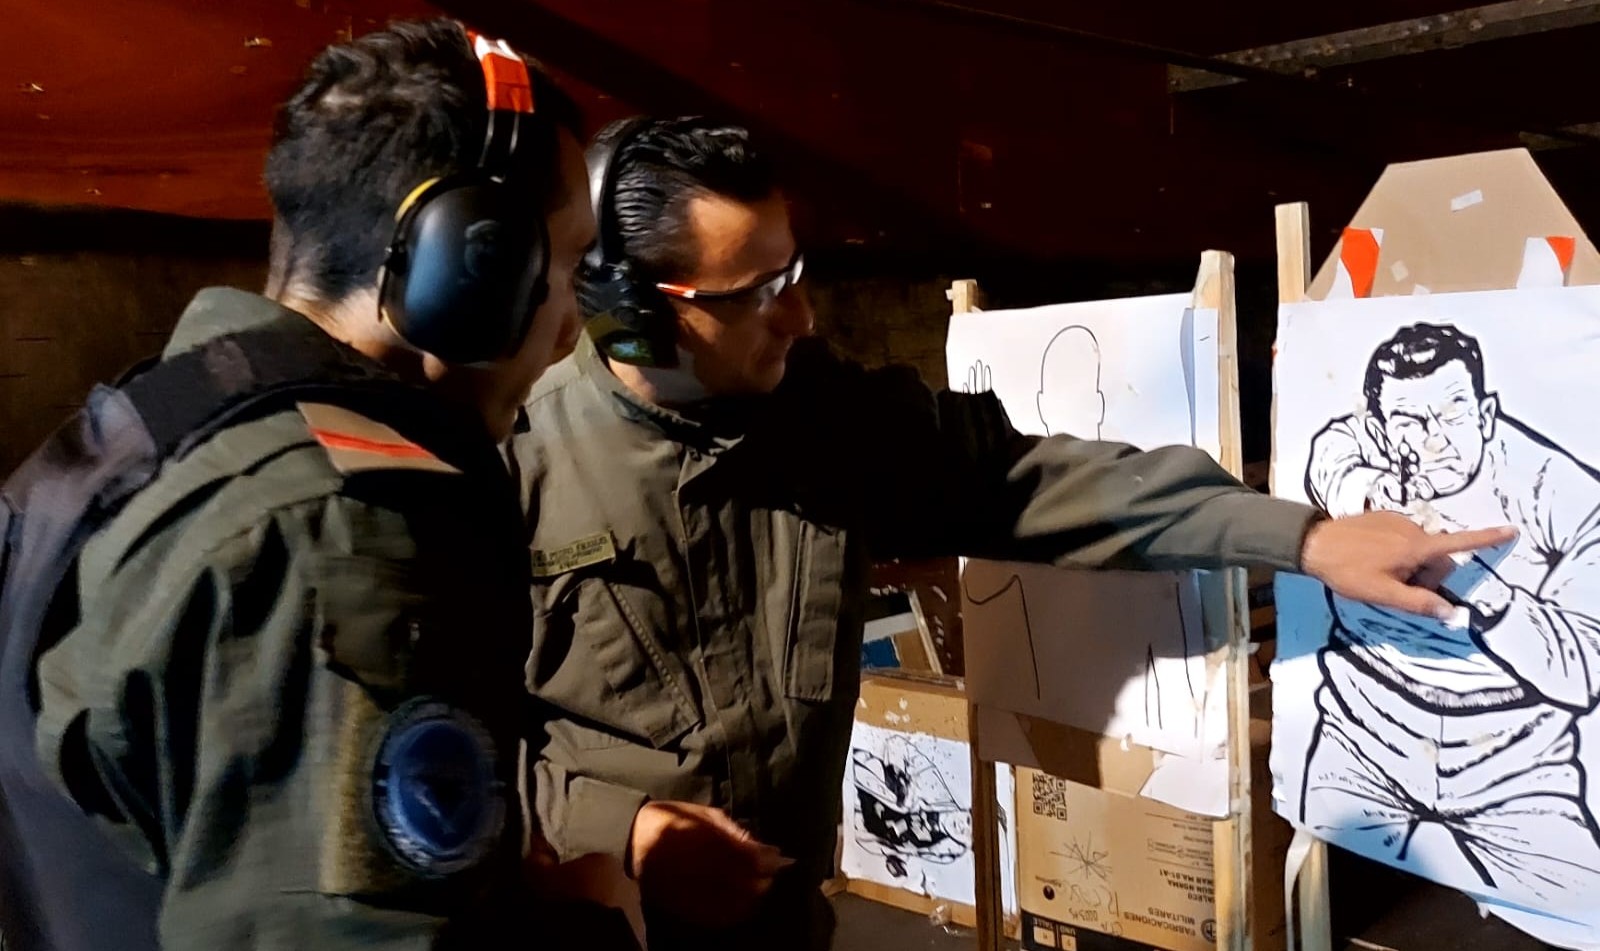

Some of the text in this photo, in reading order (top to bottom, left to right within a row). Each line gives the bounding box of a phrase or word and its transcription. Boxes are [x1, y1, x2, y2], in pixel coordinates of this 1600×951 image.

[1188, 892, 1215, 904] ALECO
[1124, 911, 1196, 937] FABRICACIONES
[1148, 906, 1196, 926] MILITARES
